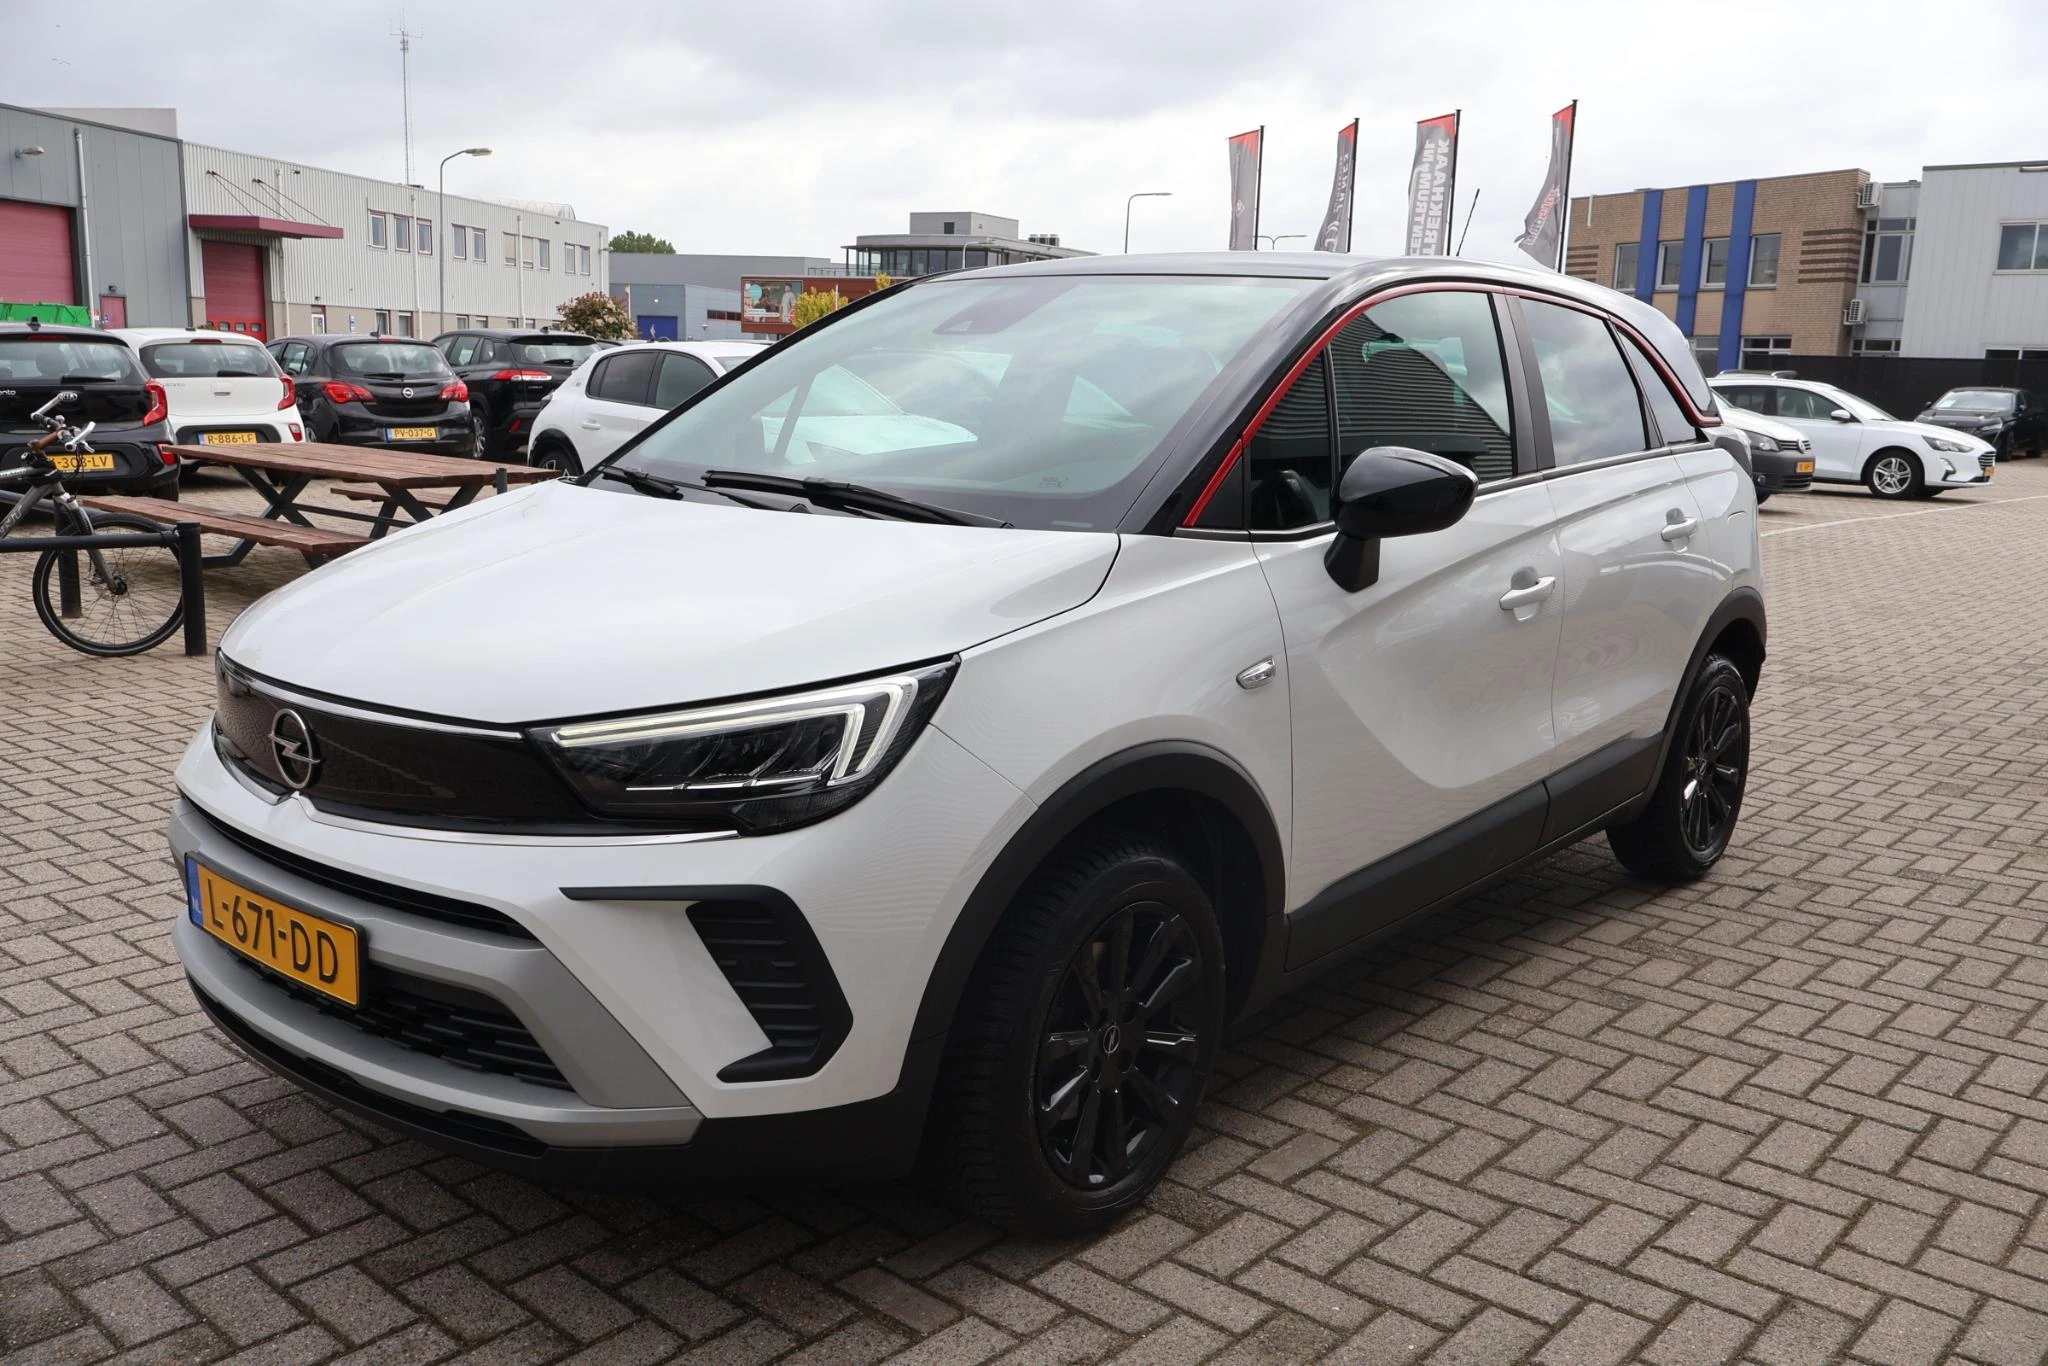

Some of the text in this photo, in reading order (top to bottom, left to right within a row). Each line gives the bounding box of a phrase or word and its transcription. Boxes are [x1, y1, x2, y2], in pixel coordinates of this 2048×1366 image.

[394, 429, 433, 437] PV-037-G
[207, 434, 254, 444] R-886-LF
[207, 878, 338, 985] L-671-DD
